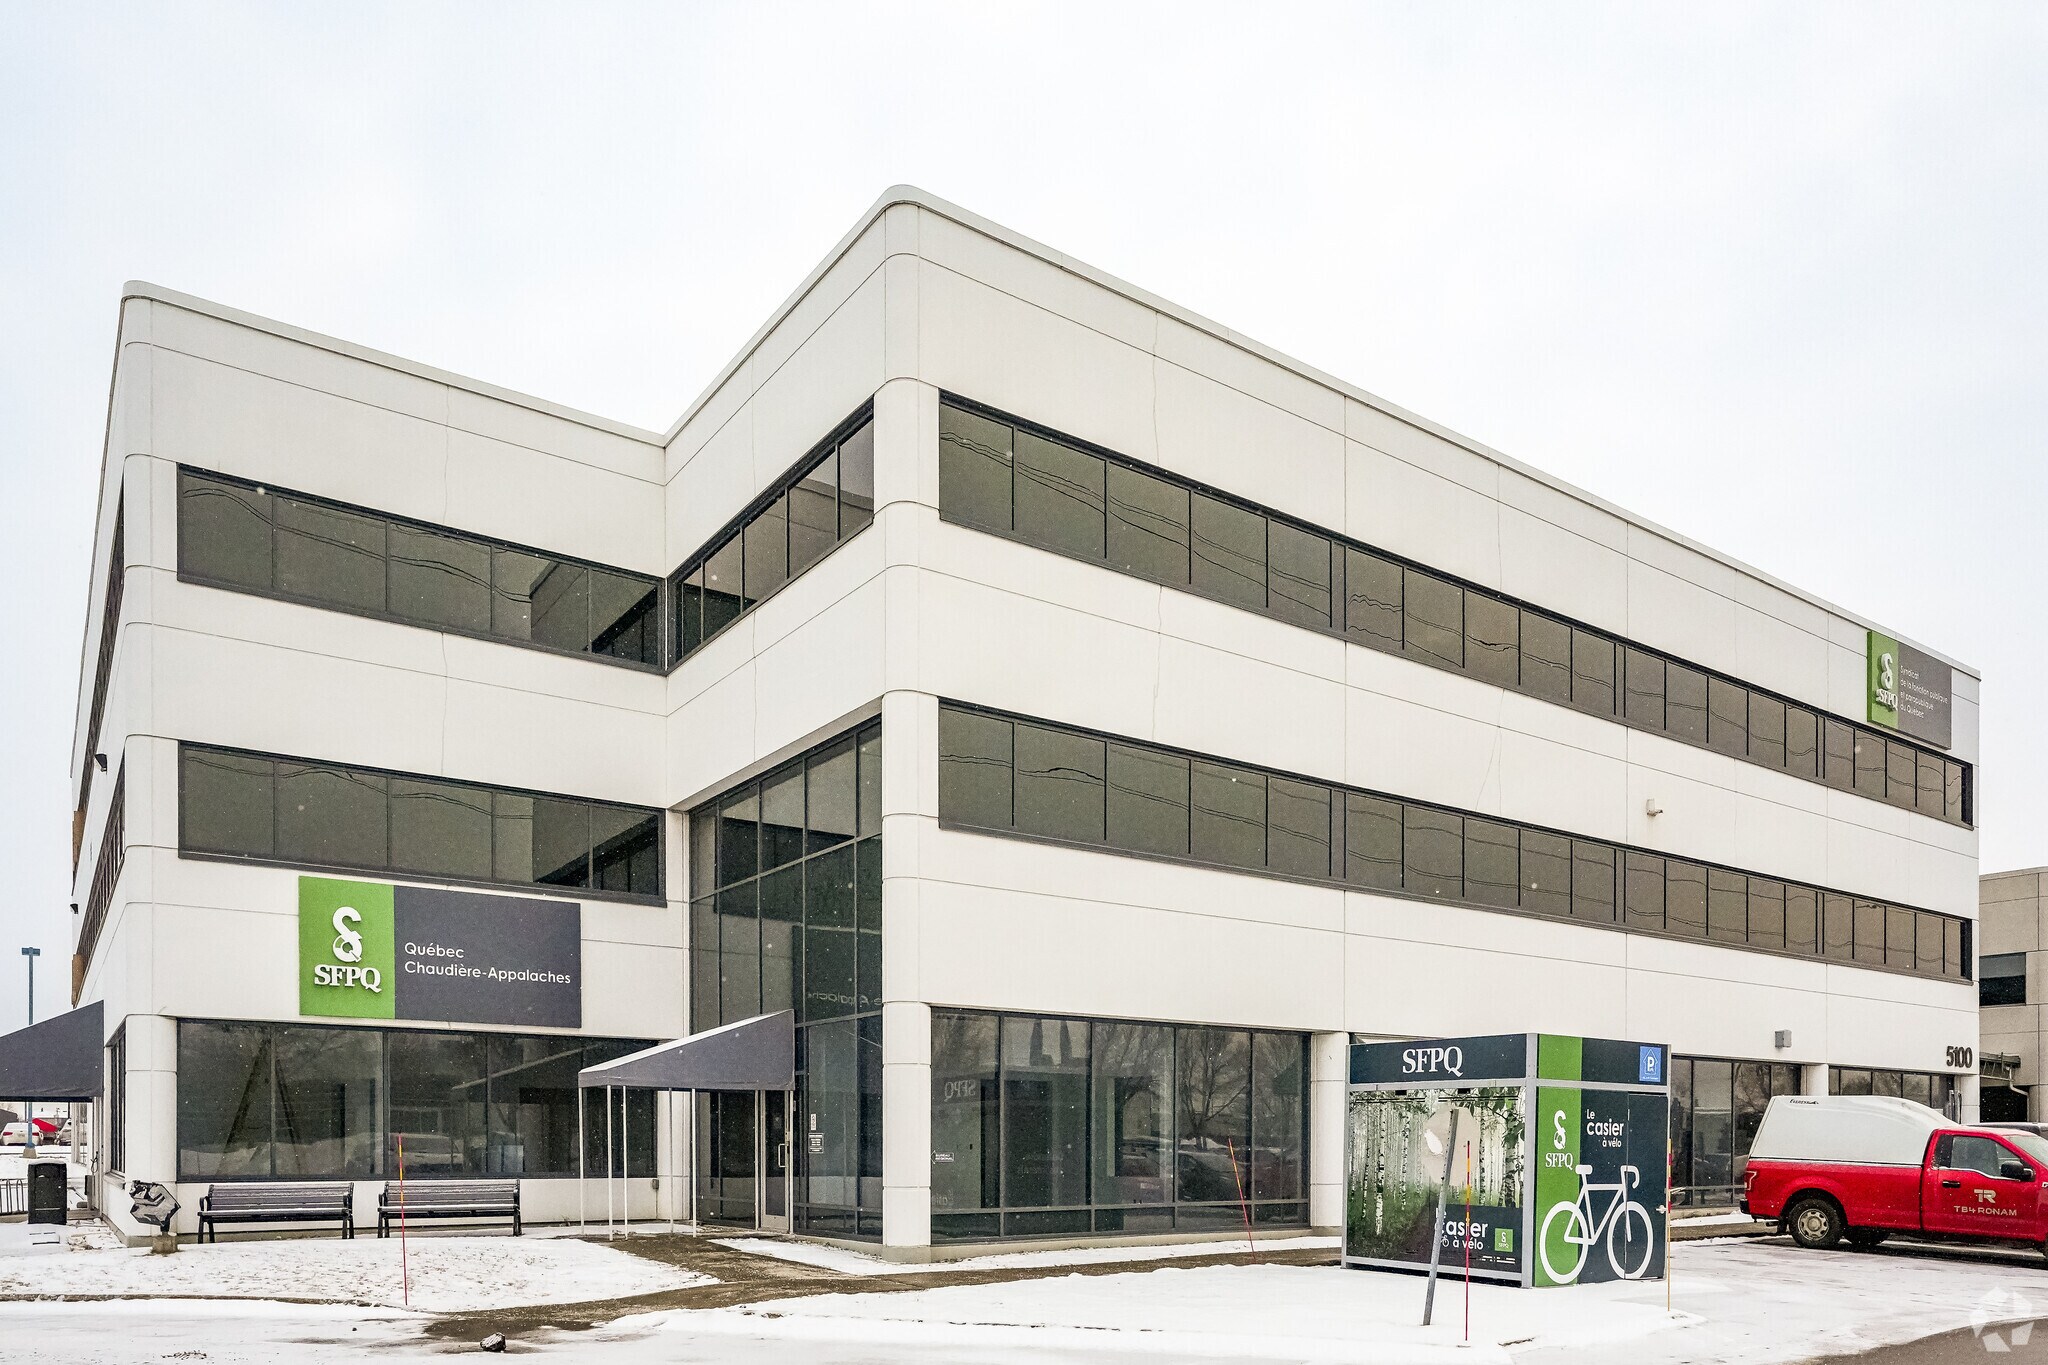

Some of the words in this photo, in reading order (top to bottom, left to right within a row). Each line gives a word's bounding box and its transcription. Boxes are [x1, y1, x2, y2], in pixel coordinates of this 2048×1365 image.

[1876, 688, 1898, 711] SFPQ
[404, 942, 465, 959] Québec
[314, 964, 382, 993] SFPQ
[404, 960, 571, 984] Chaudière-Appalaches
[1402, 1046, 1463, 1077] SFPQ
[1946, 1045, 1973, 1068] 5100
[1586, 1109, 1596, 1120] Le
[1586, 1118, 1625, 1136] casier
[1602, 1137, 1607, 1148] à
[1608, 1137, 1622, 1148] vélo
[1545, 1152, 1574, 1171] SFPQ
[1974, 1189, 1996, 1204] TR
[1977, 1207, 2017, 1216] RONAM
[1434, 1218, 1488, 1238] asier
[1452, 1236, 1460, 1248] à
